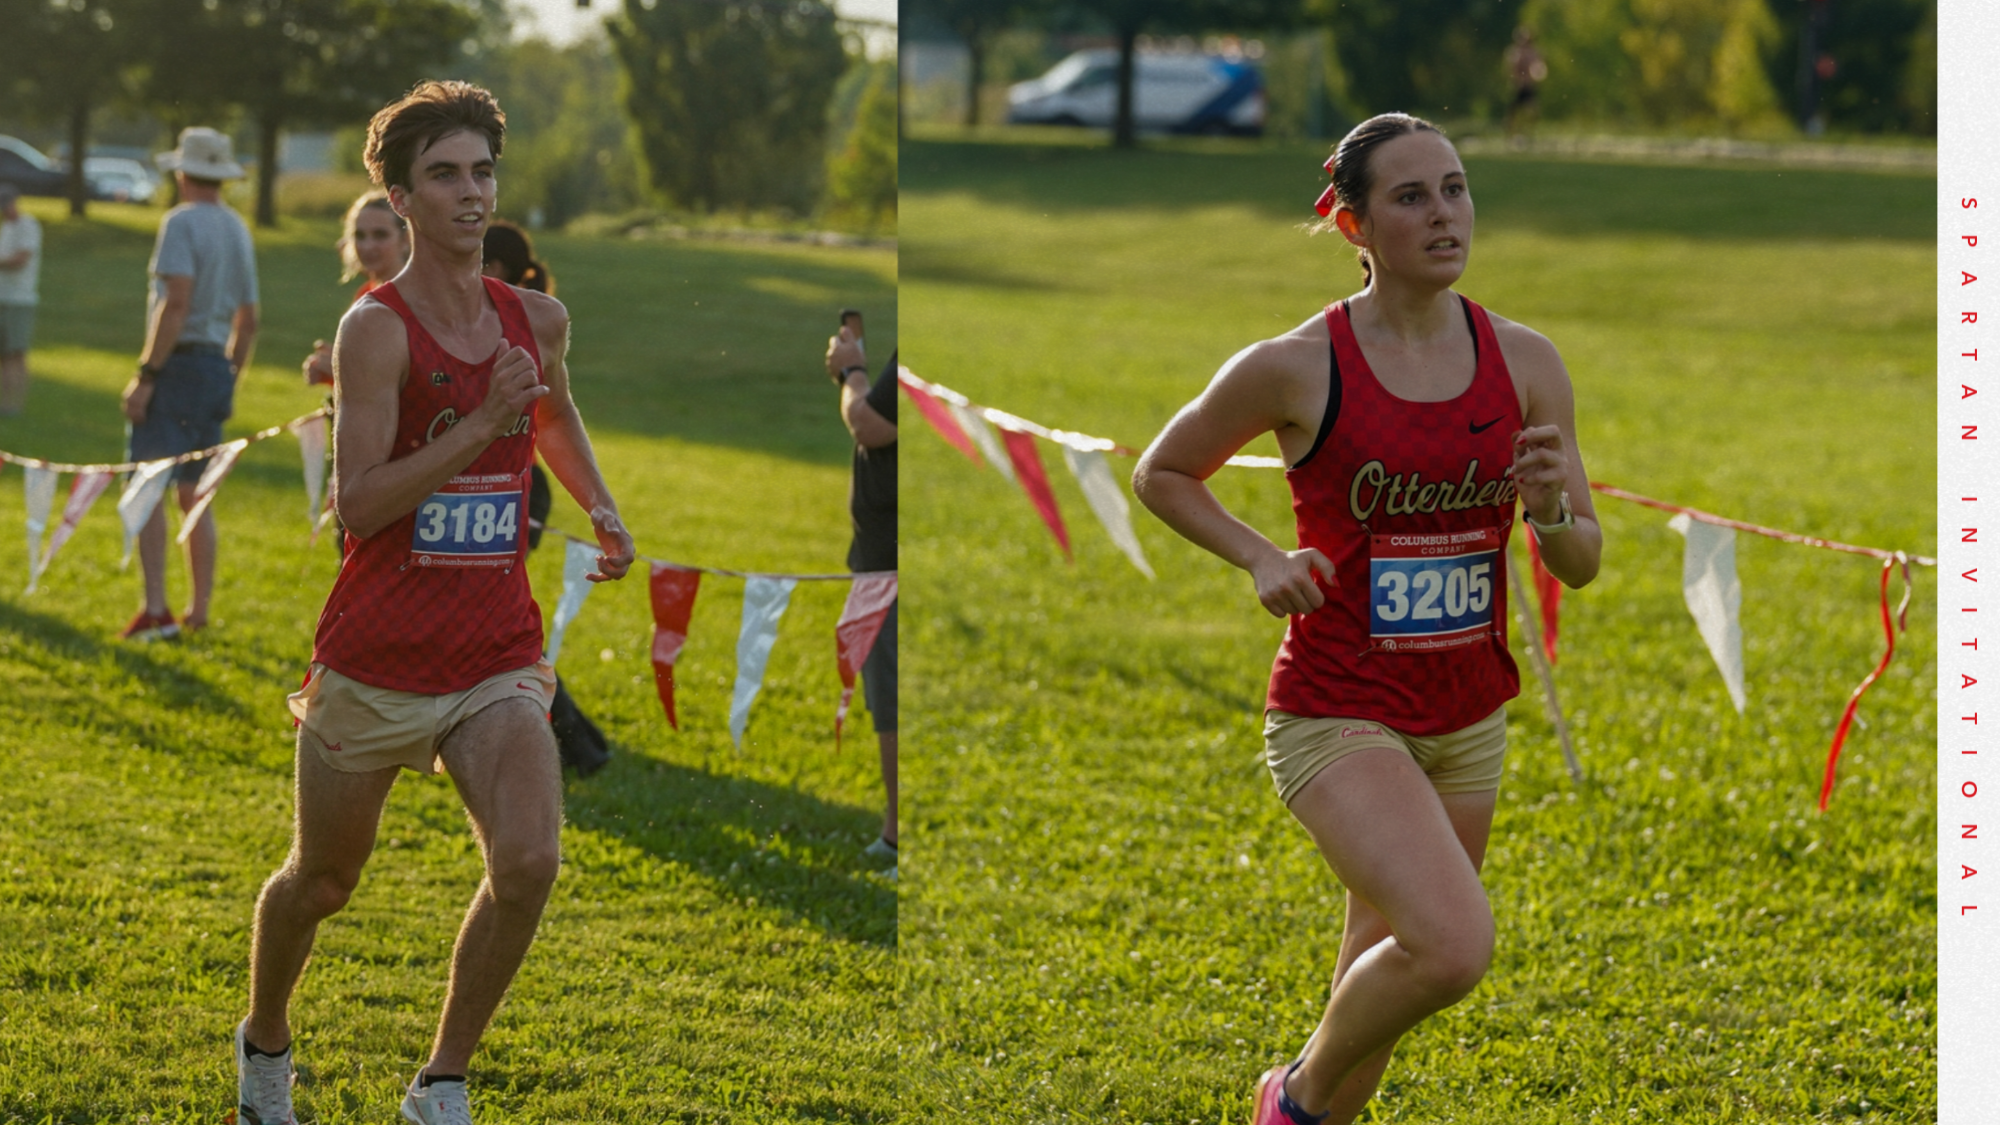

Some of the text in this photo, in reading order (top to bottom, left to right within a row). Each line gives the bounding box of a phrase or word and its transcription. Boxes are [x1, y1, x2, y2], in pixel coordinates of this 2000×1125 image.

[419, 501, 517, 543] 3184
[1390, 530, 1486, 546] COLUMBUS RUNNING
[1421, 544, 1466, 555] COMPANY
[1376, 562, 1491, 622] 3205
